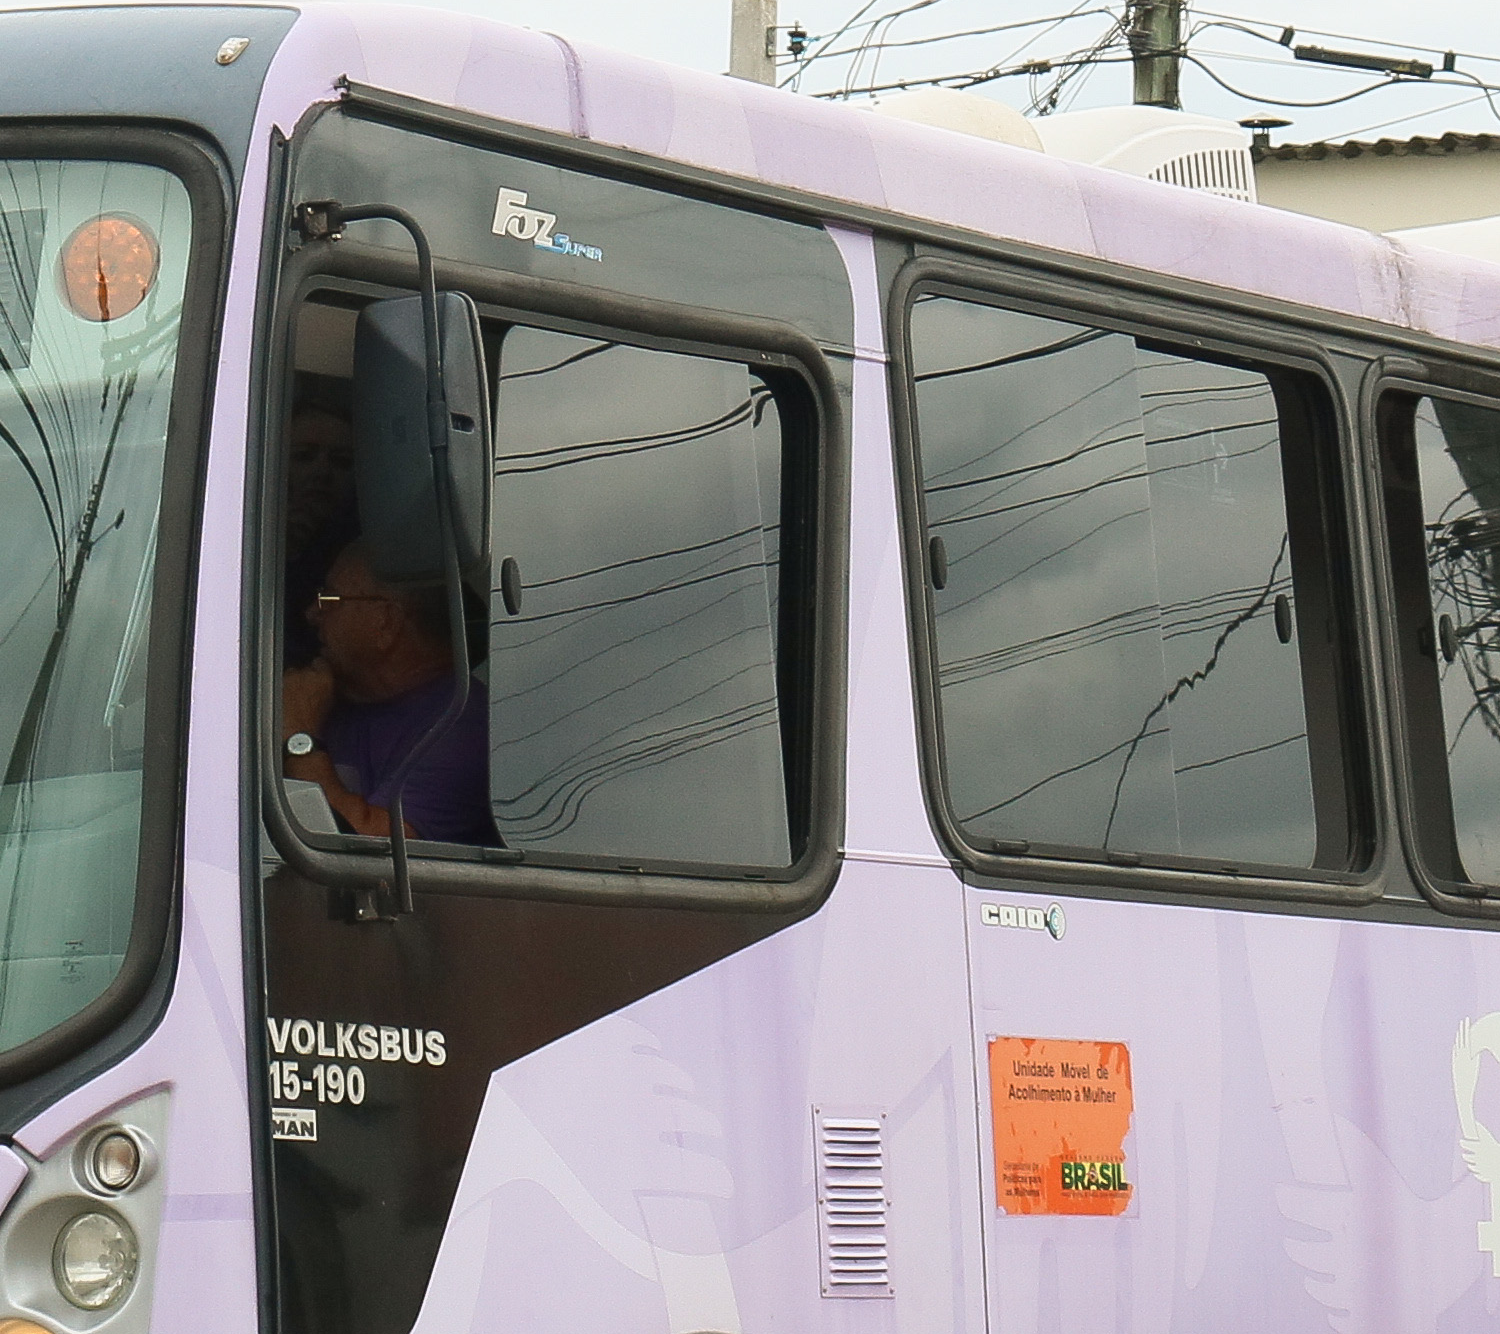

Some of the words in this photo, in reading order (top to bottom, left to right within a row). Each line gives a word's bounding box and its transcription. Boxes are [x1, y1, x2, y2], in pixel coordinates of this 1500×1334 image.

[981, 903, 1045, 930] CAIO
[266, 1017, 447, 1066] VOLKSBUS
[269, 1060, 366, 1105] 15-190
[1012, 1060, 1055, 1078] Unidade
[1061, 1061, 1090, 1080] Móvel
[1096, 1066, 1109, 1080] de
[1008, 1084, 1072, 1102] Acolhimento
[1082, 1086, 1116, 1104] Mulher
[273, 1119, 315, 1137] MAN
[1060, 1162, 1129, 1191] BRASIL
